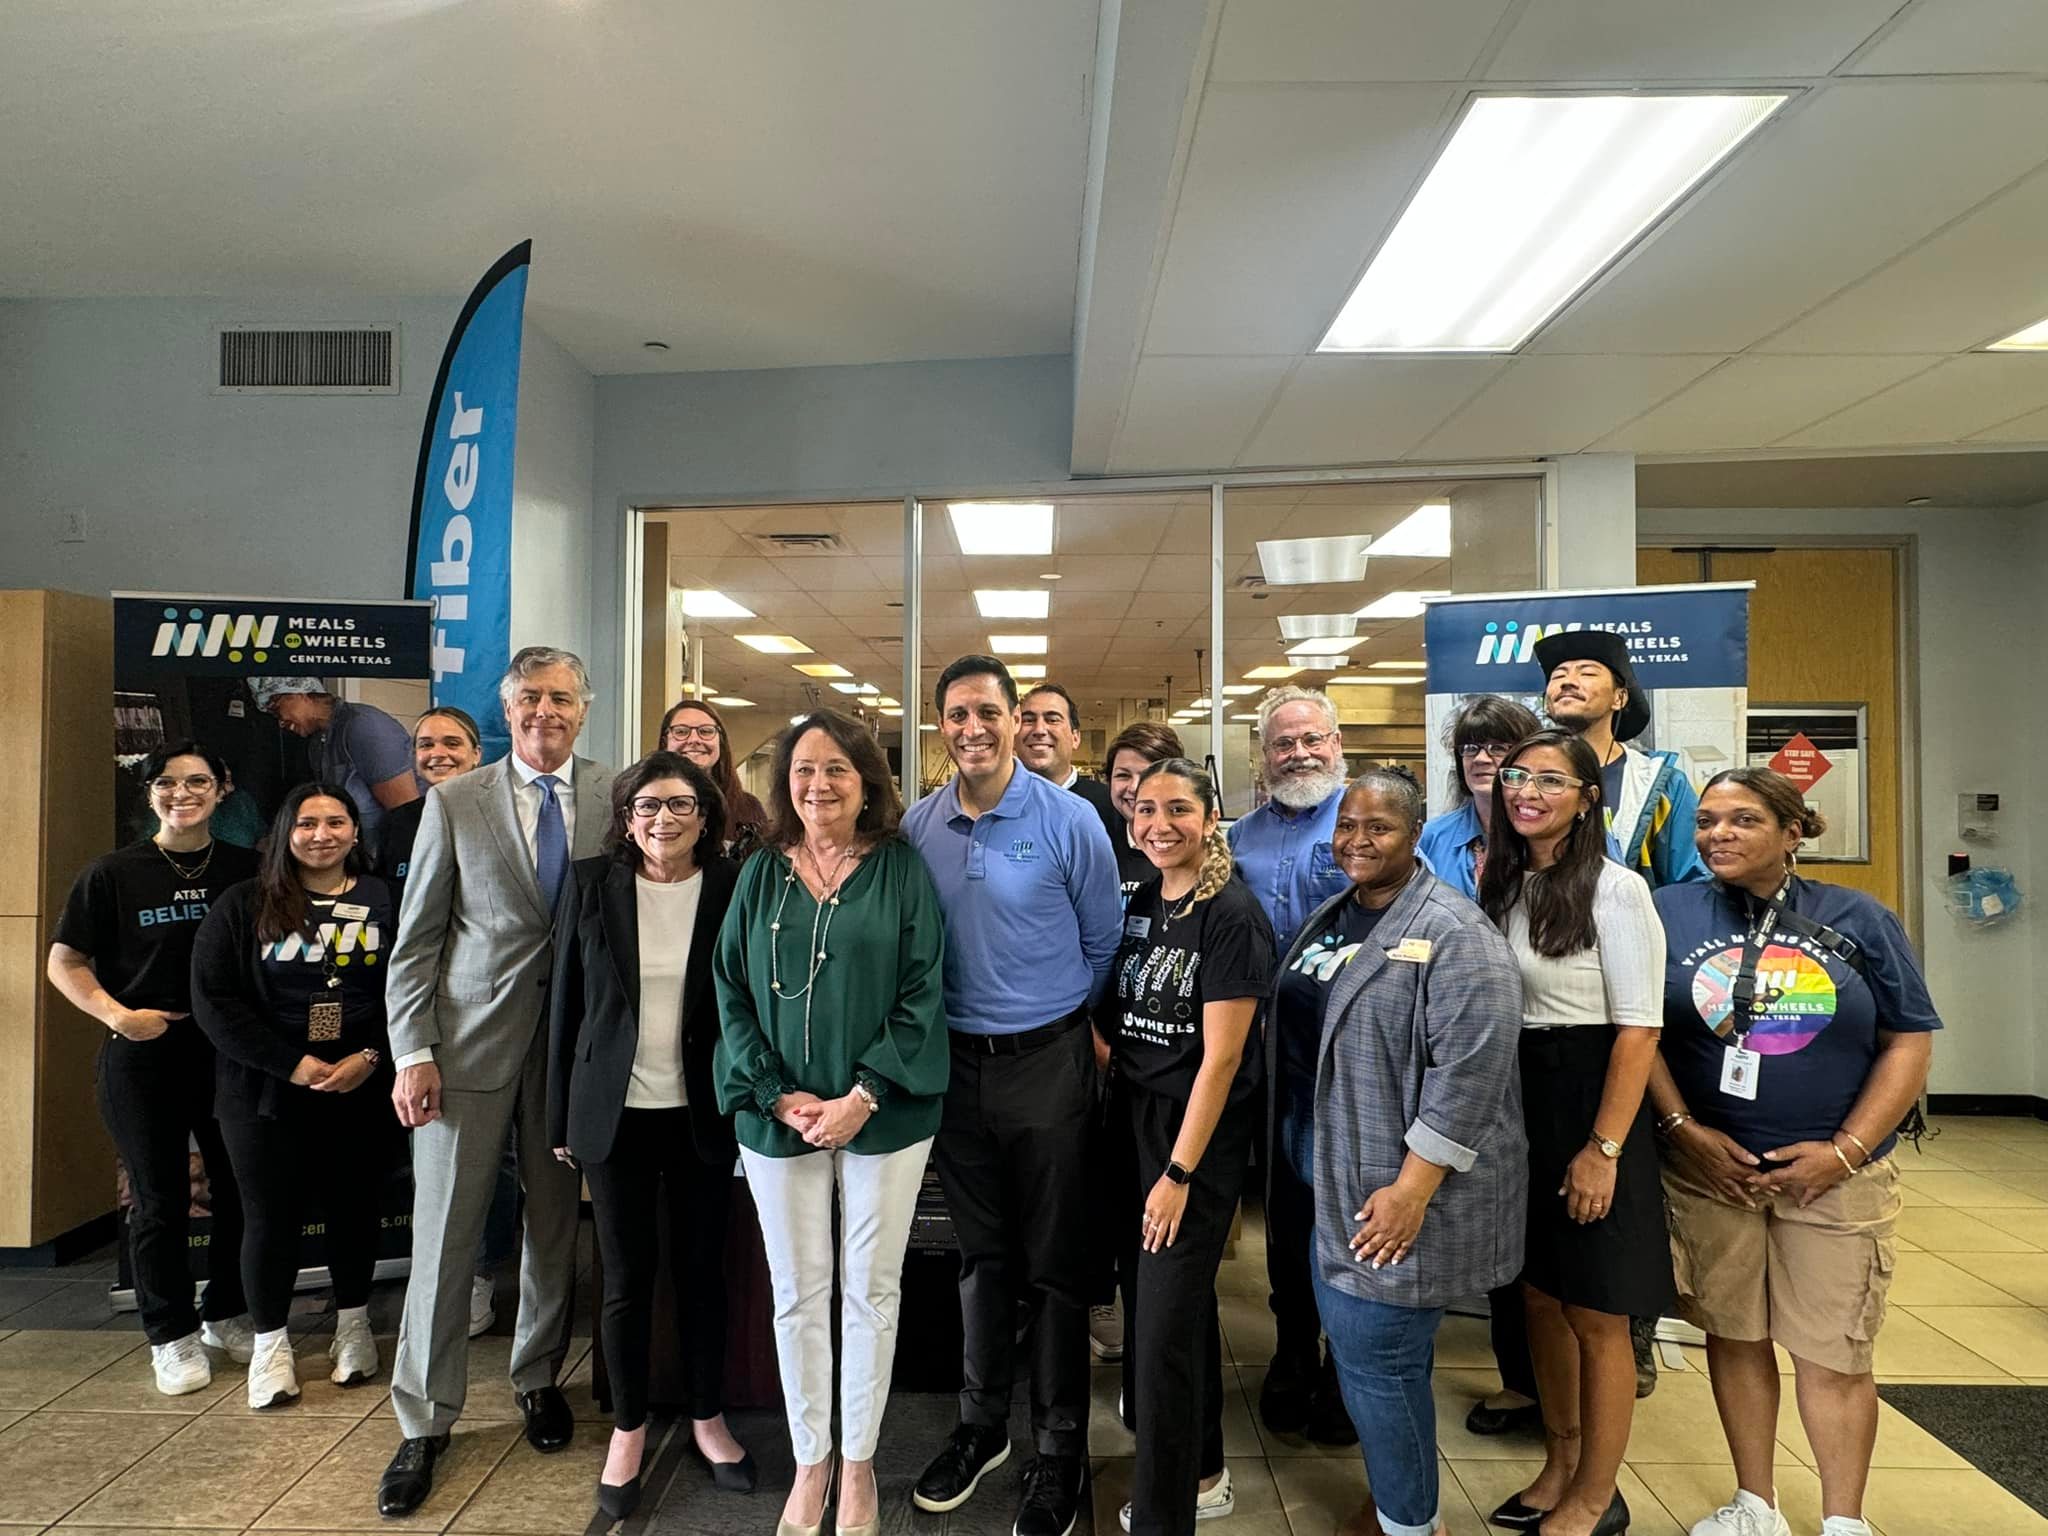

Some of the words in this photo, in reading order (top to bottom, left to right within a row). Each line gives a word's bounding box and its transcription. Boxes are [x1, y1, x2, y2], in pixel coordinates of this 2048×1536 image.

[289, 617, 356, 630] MEALS
[1589, 621, 1653, 634] MEALS
[303, 636, 386, 649] WHEELS
[1625, 636, 1681, 650] HEELS
[289, 655, 348, 664] CENTRAL
[350, 656, 391, 665] TEXAS
[1648, 653, 1688, 663] TEXAS
[173, 888, 208, 901] AT&T
[1681, 939, 1726, 966] Y'ALL
[1799, 941, 1829, 963] ALL
[1134, 946, 1159, 1000] VOLUNTEER
[1151, 948, 1176, 991] SUPPORT
[1766, 1003, 1824, 1012] WHEELS
[1133, 1016, 1195, 1034] WHEELS
[1141, 1032, 1170, 1046] TEXAS
